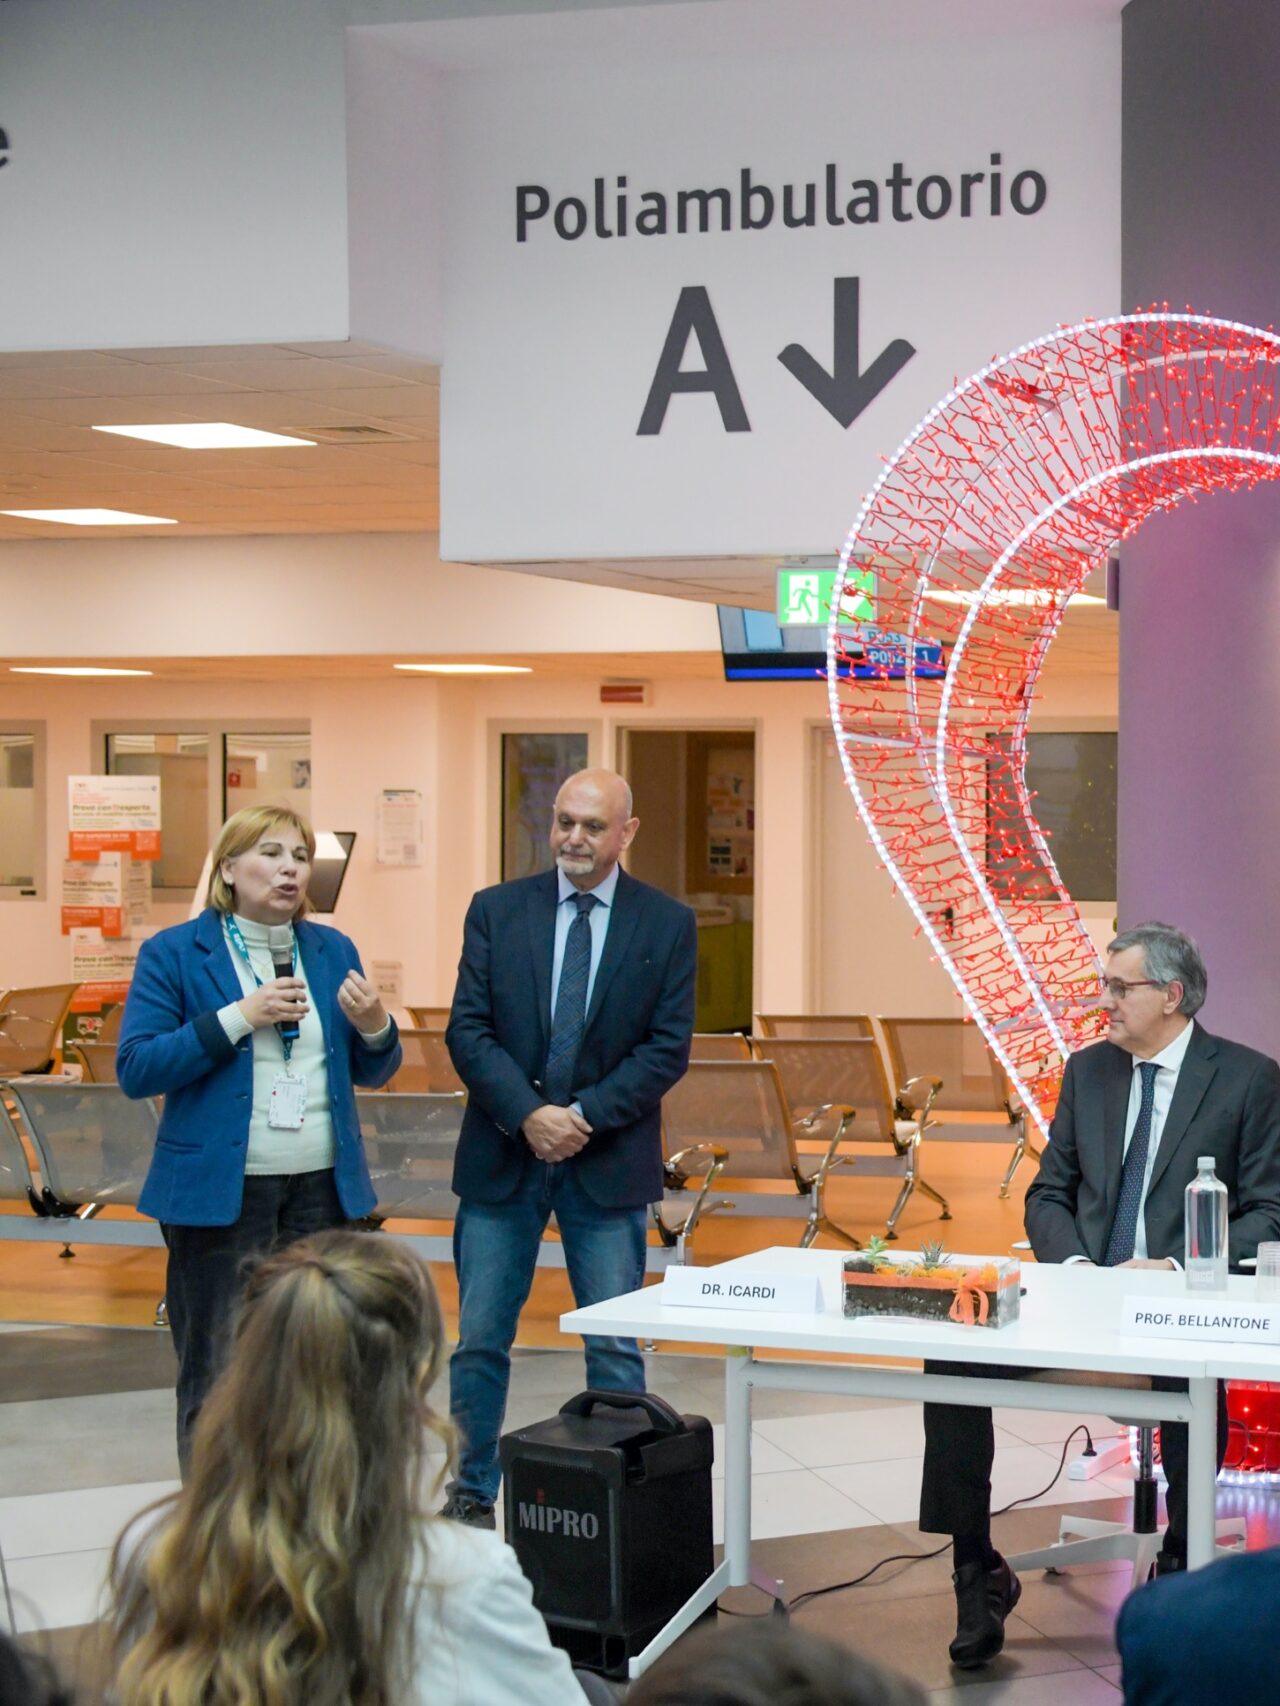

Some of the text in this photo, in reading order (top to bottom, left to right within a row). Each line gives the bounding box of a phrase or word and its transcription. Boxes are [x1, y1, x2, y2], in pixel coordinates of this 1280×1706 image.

[516, 152, 1048, 243] Poliambulatorio
[635, 285, 752, 436] A
[701, 1282, 776, 1299] DR. ICARDI
[1134, 1311, 1271, 1331] PROF. BELLANTONE
